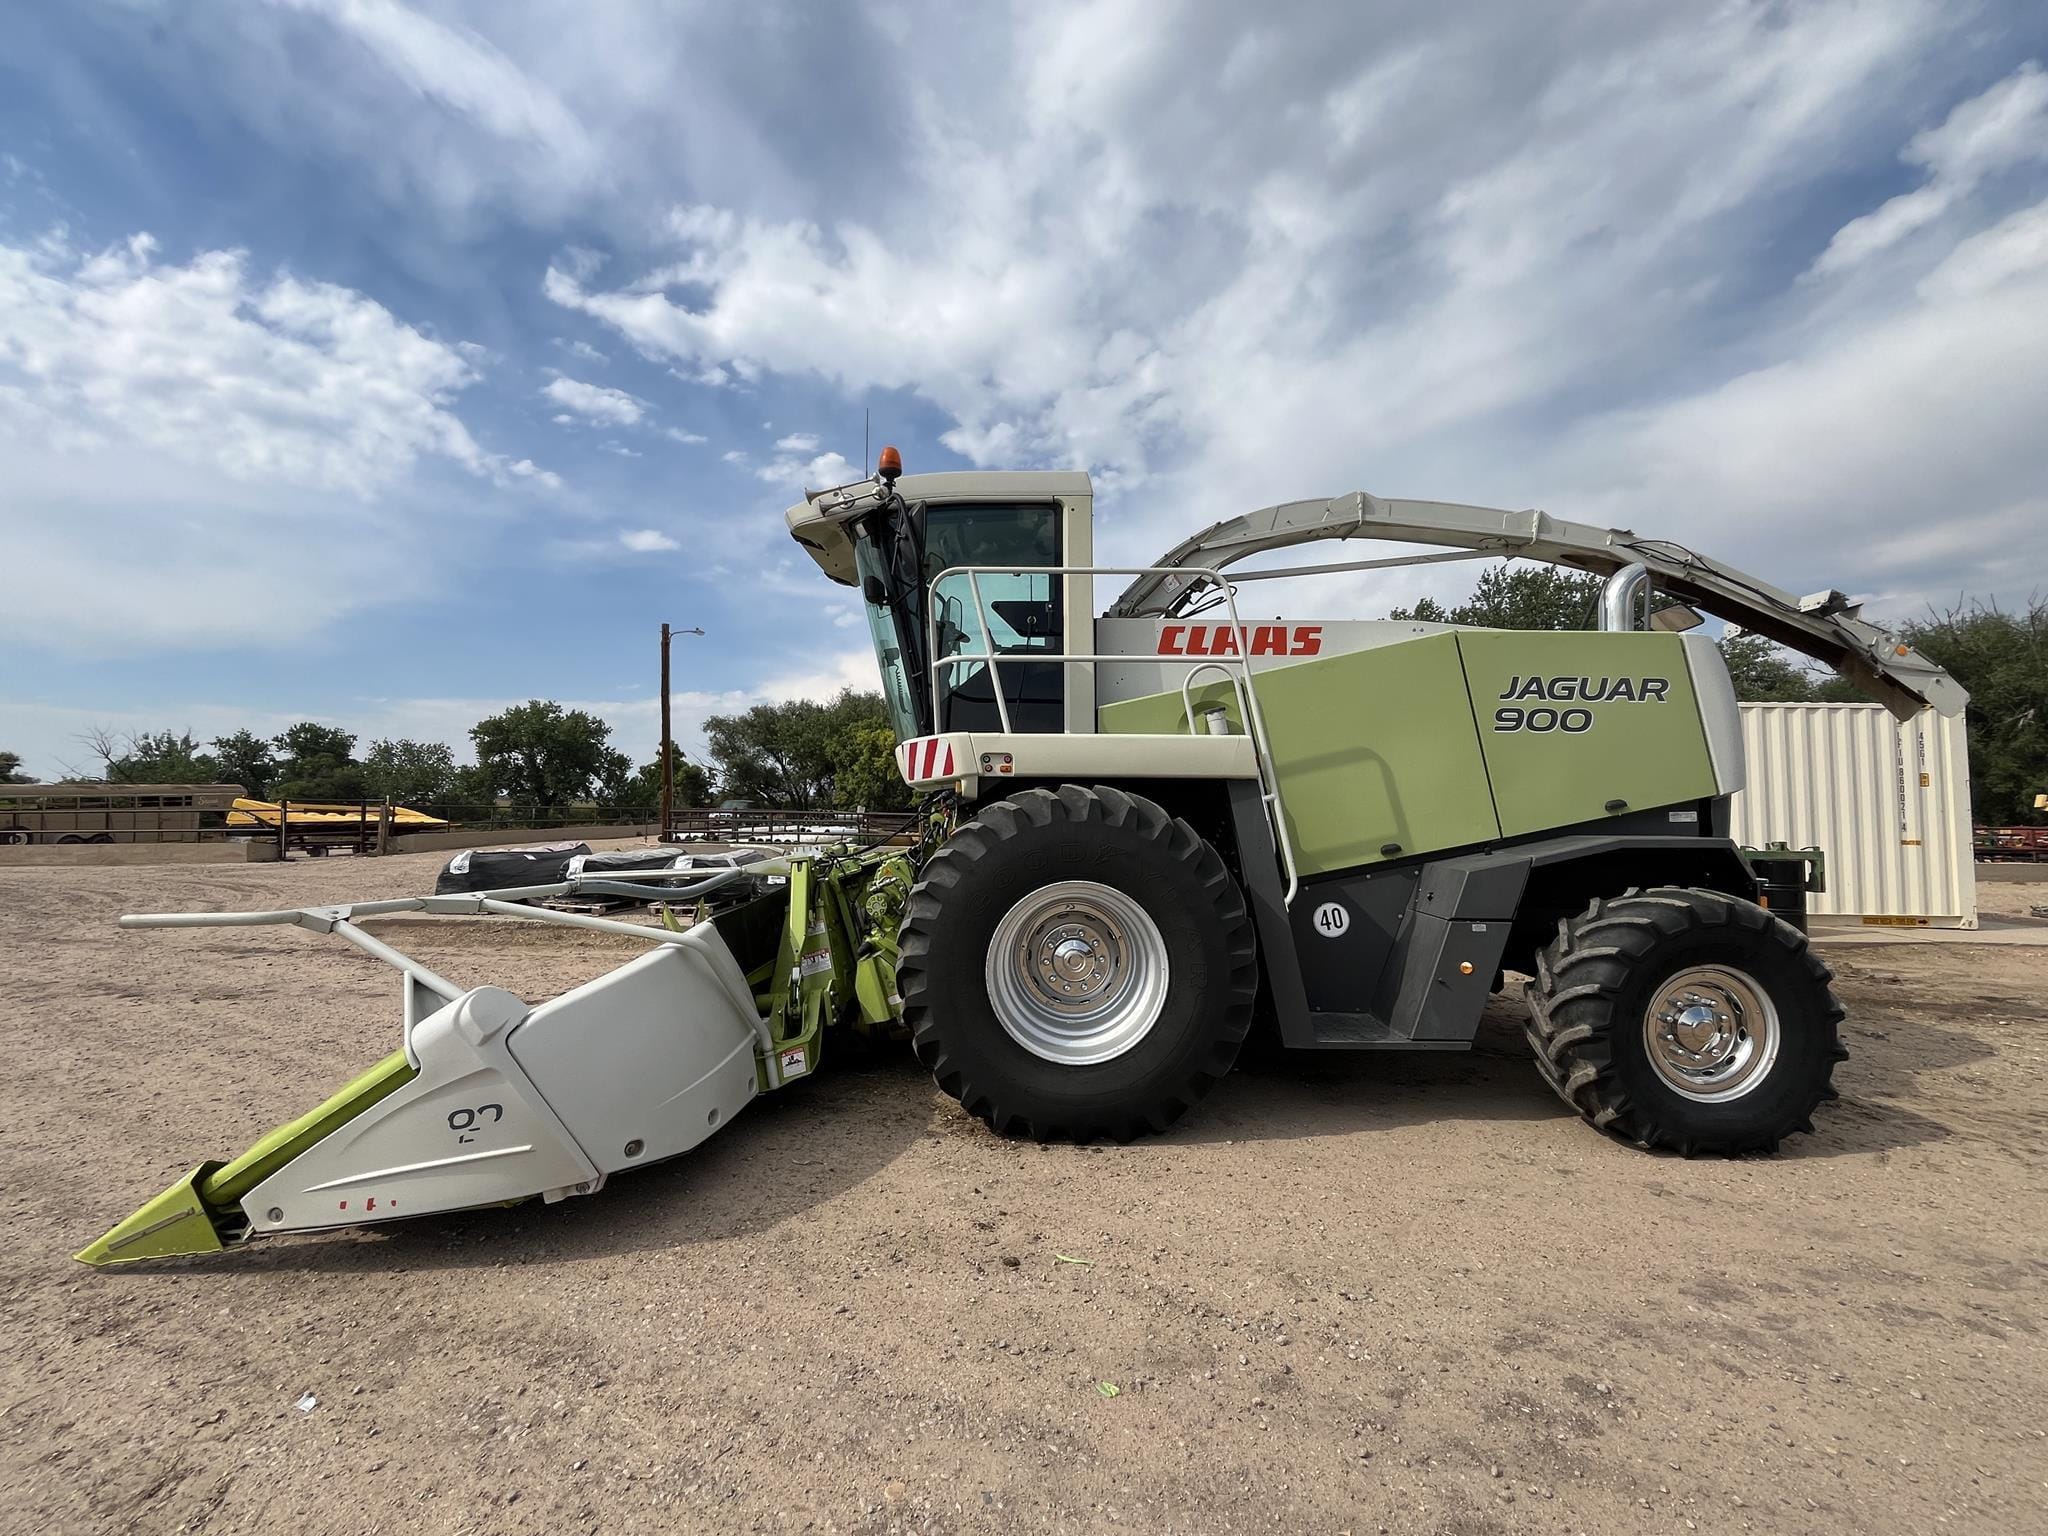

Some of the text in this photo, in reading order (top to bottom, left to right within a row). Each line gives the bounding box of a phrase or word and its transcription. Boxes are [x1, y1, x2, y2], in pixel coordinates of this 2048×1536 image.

[1157, 625, 1323, 656] CLAAS
[1499, 675, 1670, 703] JAGUAR
[1494, 707, 1593, 734] 900
[1320, 907, 1344, 931] 40
